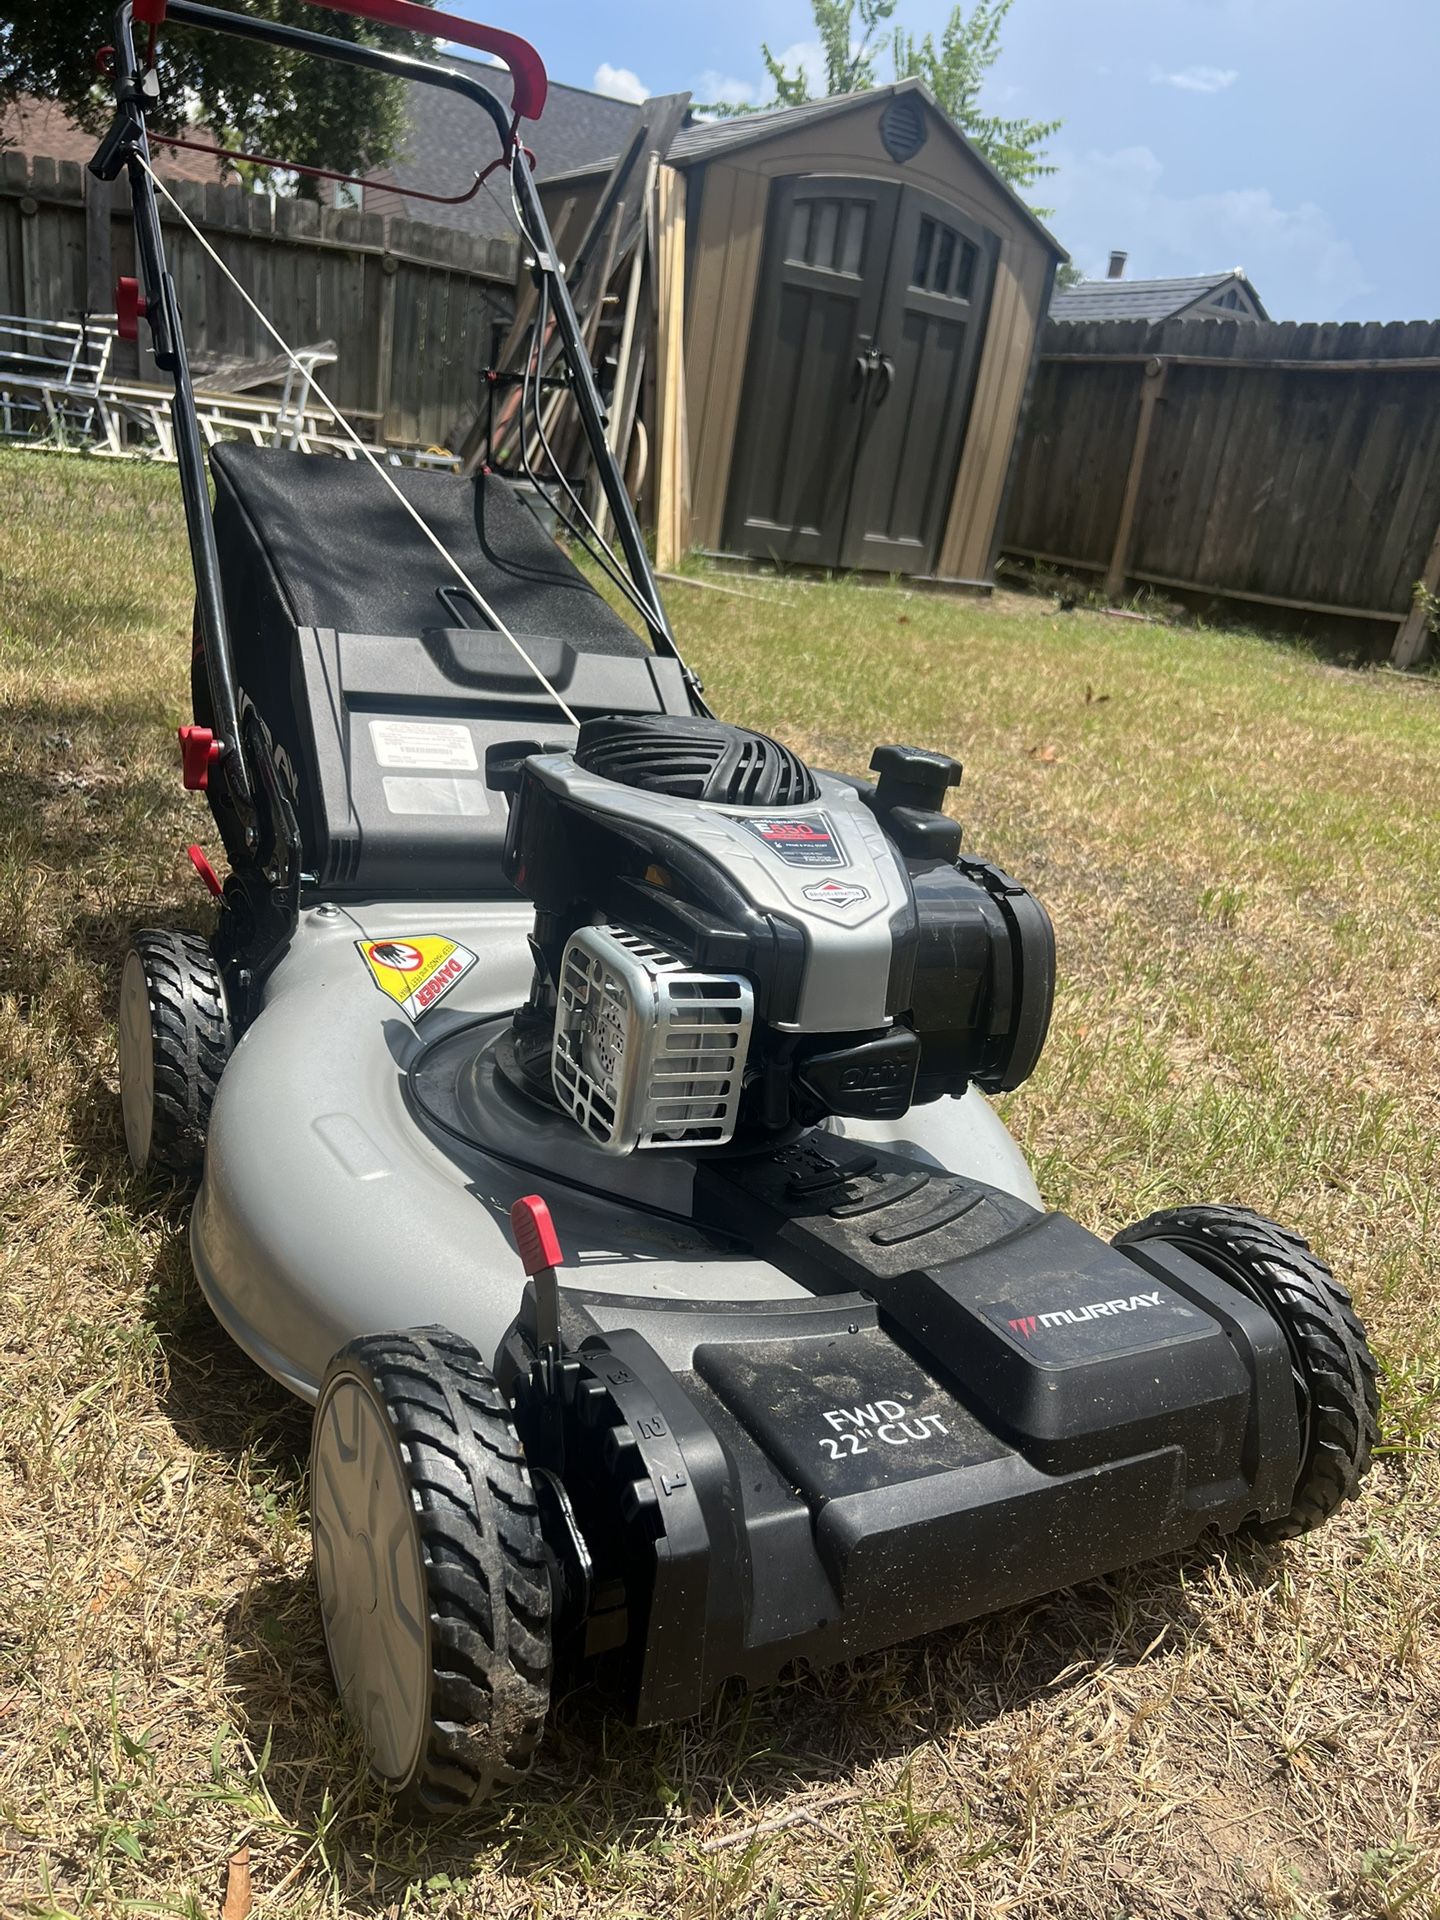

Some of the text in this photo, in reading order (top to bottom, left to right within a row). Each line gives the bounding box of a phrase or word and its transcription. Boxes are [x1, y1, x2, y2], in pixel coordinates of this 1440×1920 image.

[753, 823, 814, 834] E550
[426, 955, 443, 971] HANDS
[410, 976, 423, 988] FEET
[415, 958, 463, 1007] DANGER
[1037, 1291, 1161, 1328] MURRAY
[636, 1415, 667, 1440] 2
[822, 1400, 906, 1432] FWD
[818, 1413, 950, 1460] 22" CUT
[660, 1473, 687, 1497] 1
